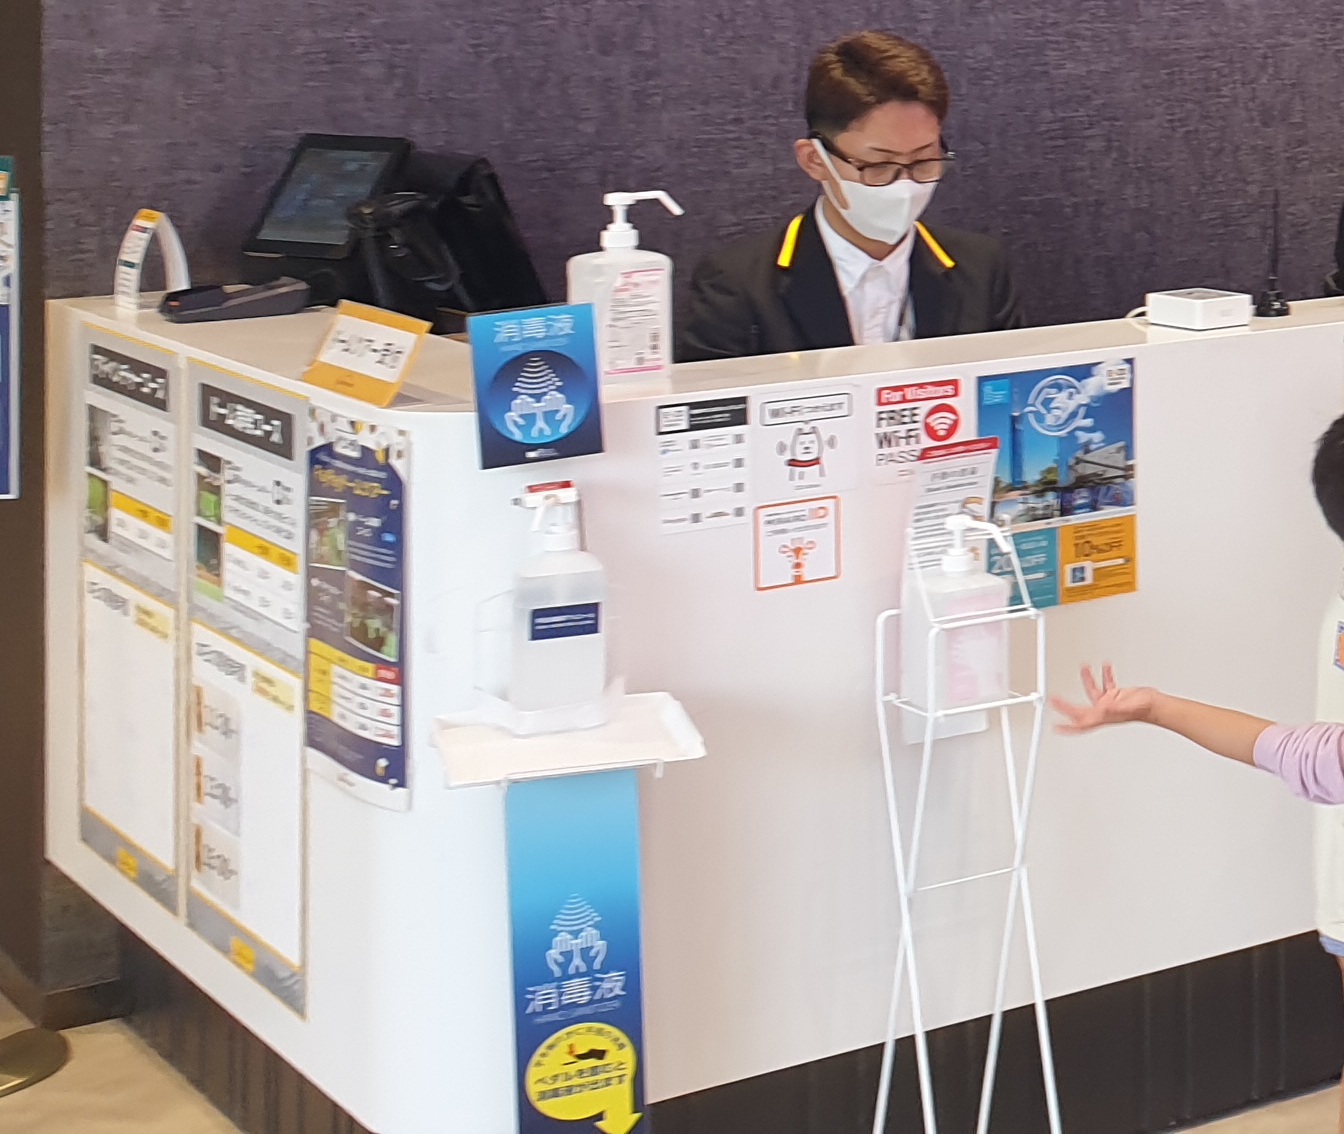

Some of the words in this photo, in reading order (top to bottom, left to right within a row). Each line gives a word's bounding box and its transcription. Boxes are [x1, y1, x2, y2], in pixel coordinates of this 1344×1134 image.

[493, 314, 575, 343] 消毒液
[876, 407, 921, 428] FREE
[875, 428, 921, 449] Wi-Fi
[876, 449, 919, 466] PASS
[525, 970, 627, 1014] 消毒液
